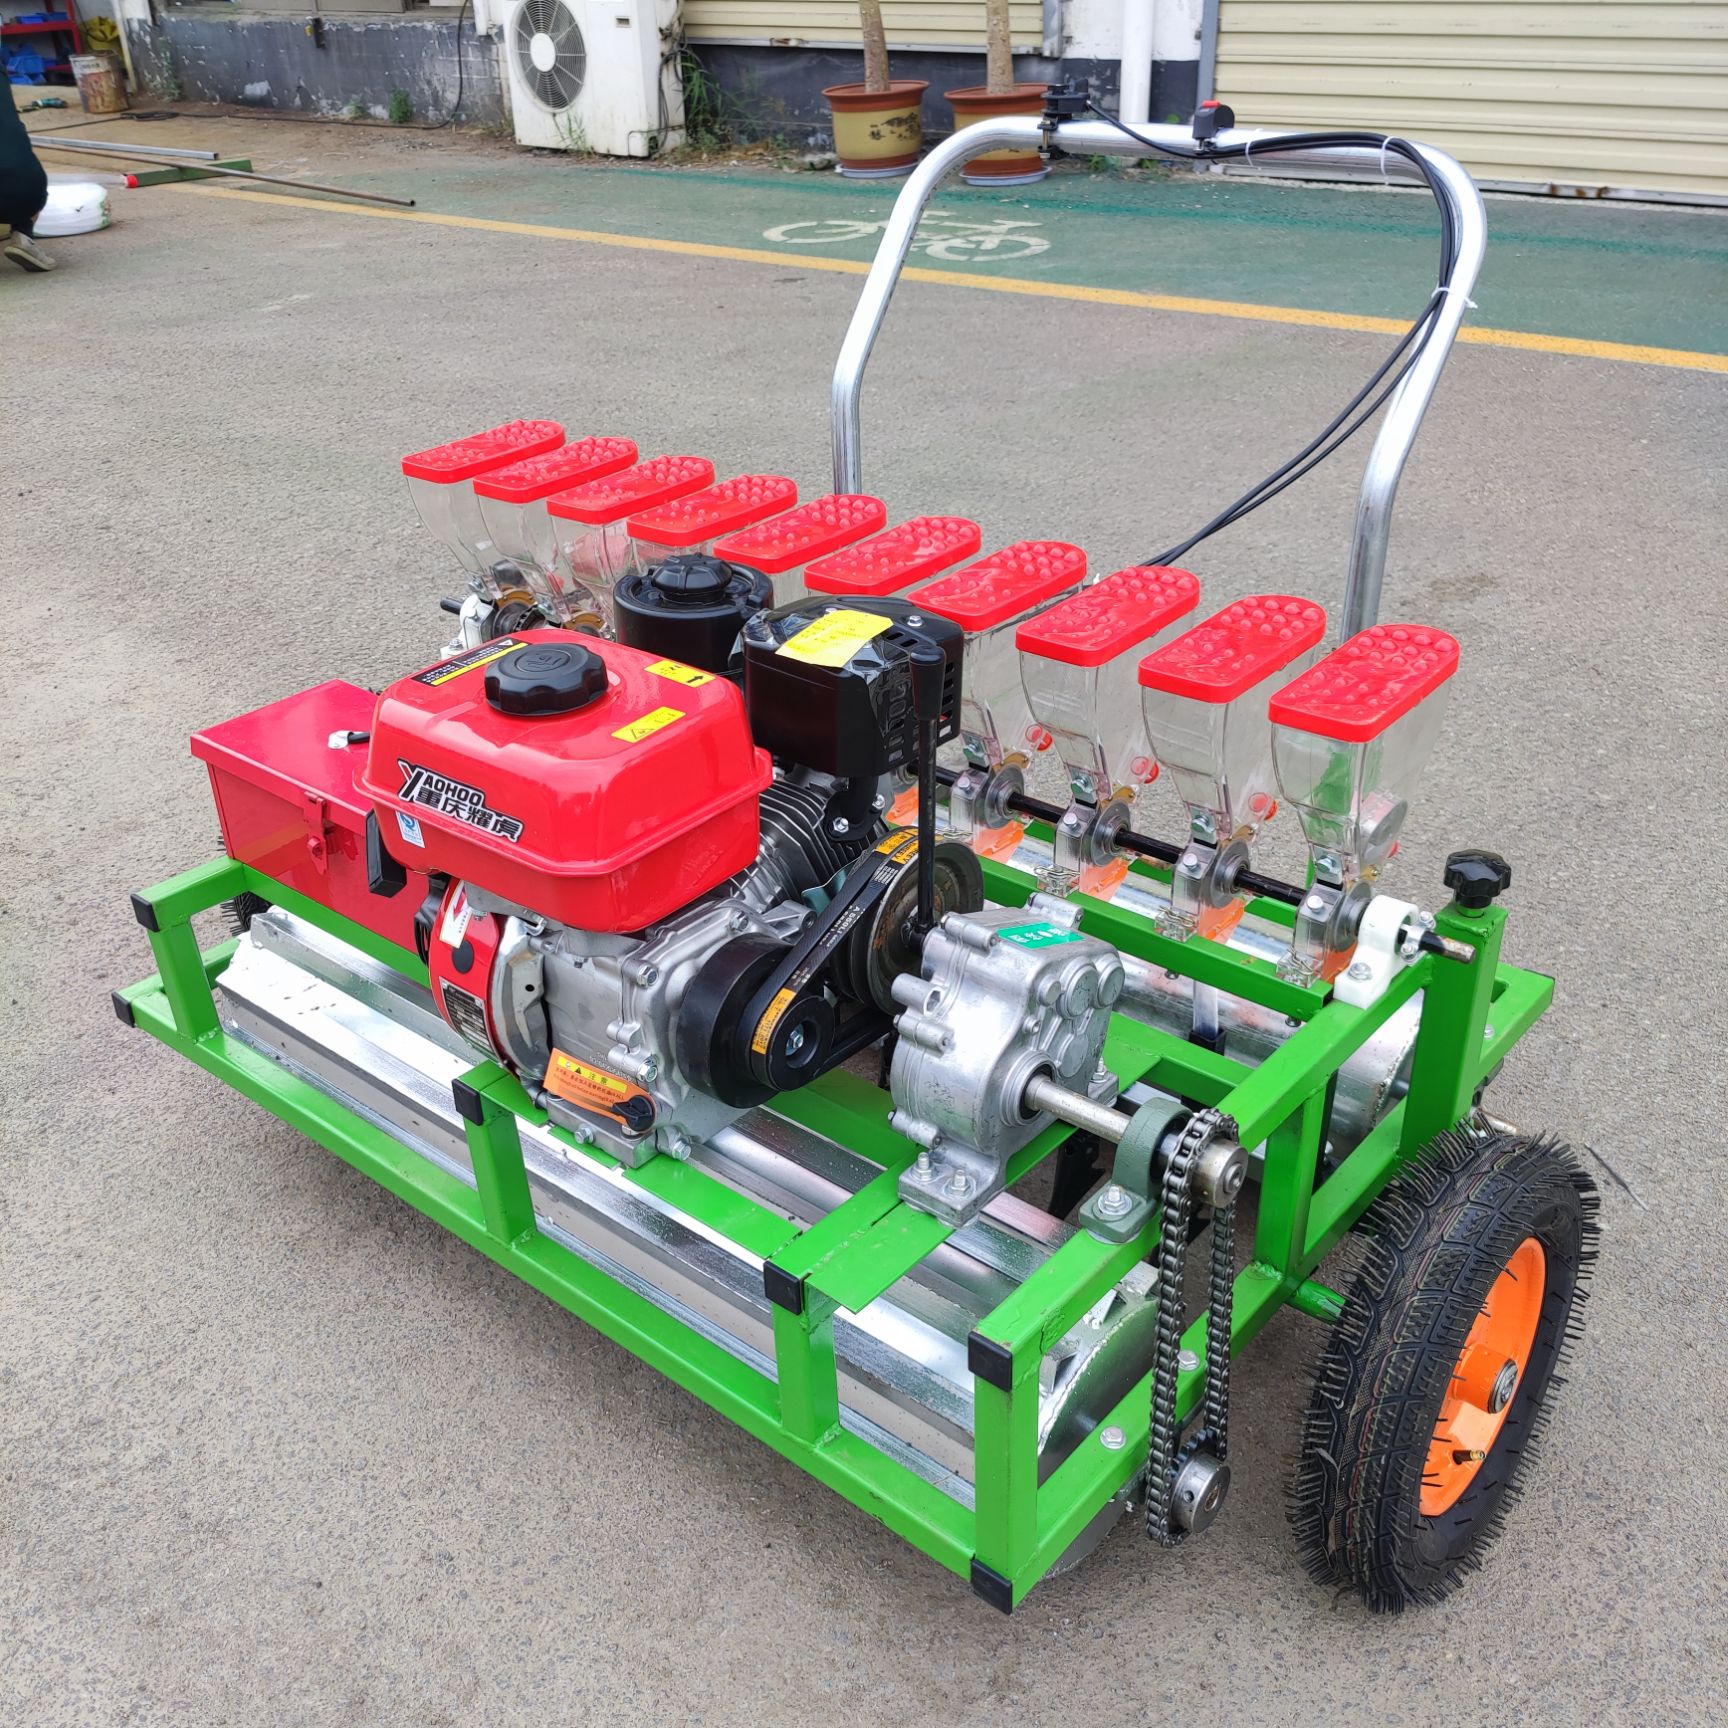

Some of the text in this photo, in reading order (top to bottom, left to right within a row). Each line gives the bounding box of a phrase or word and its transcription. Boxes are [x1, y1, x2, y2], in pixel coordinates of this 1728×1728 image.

[397, 760, 484, 807] YAOHOO
[415, 786, 521, 841] 重庆耀虎
